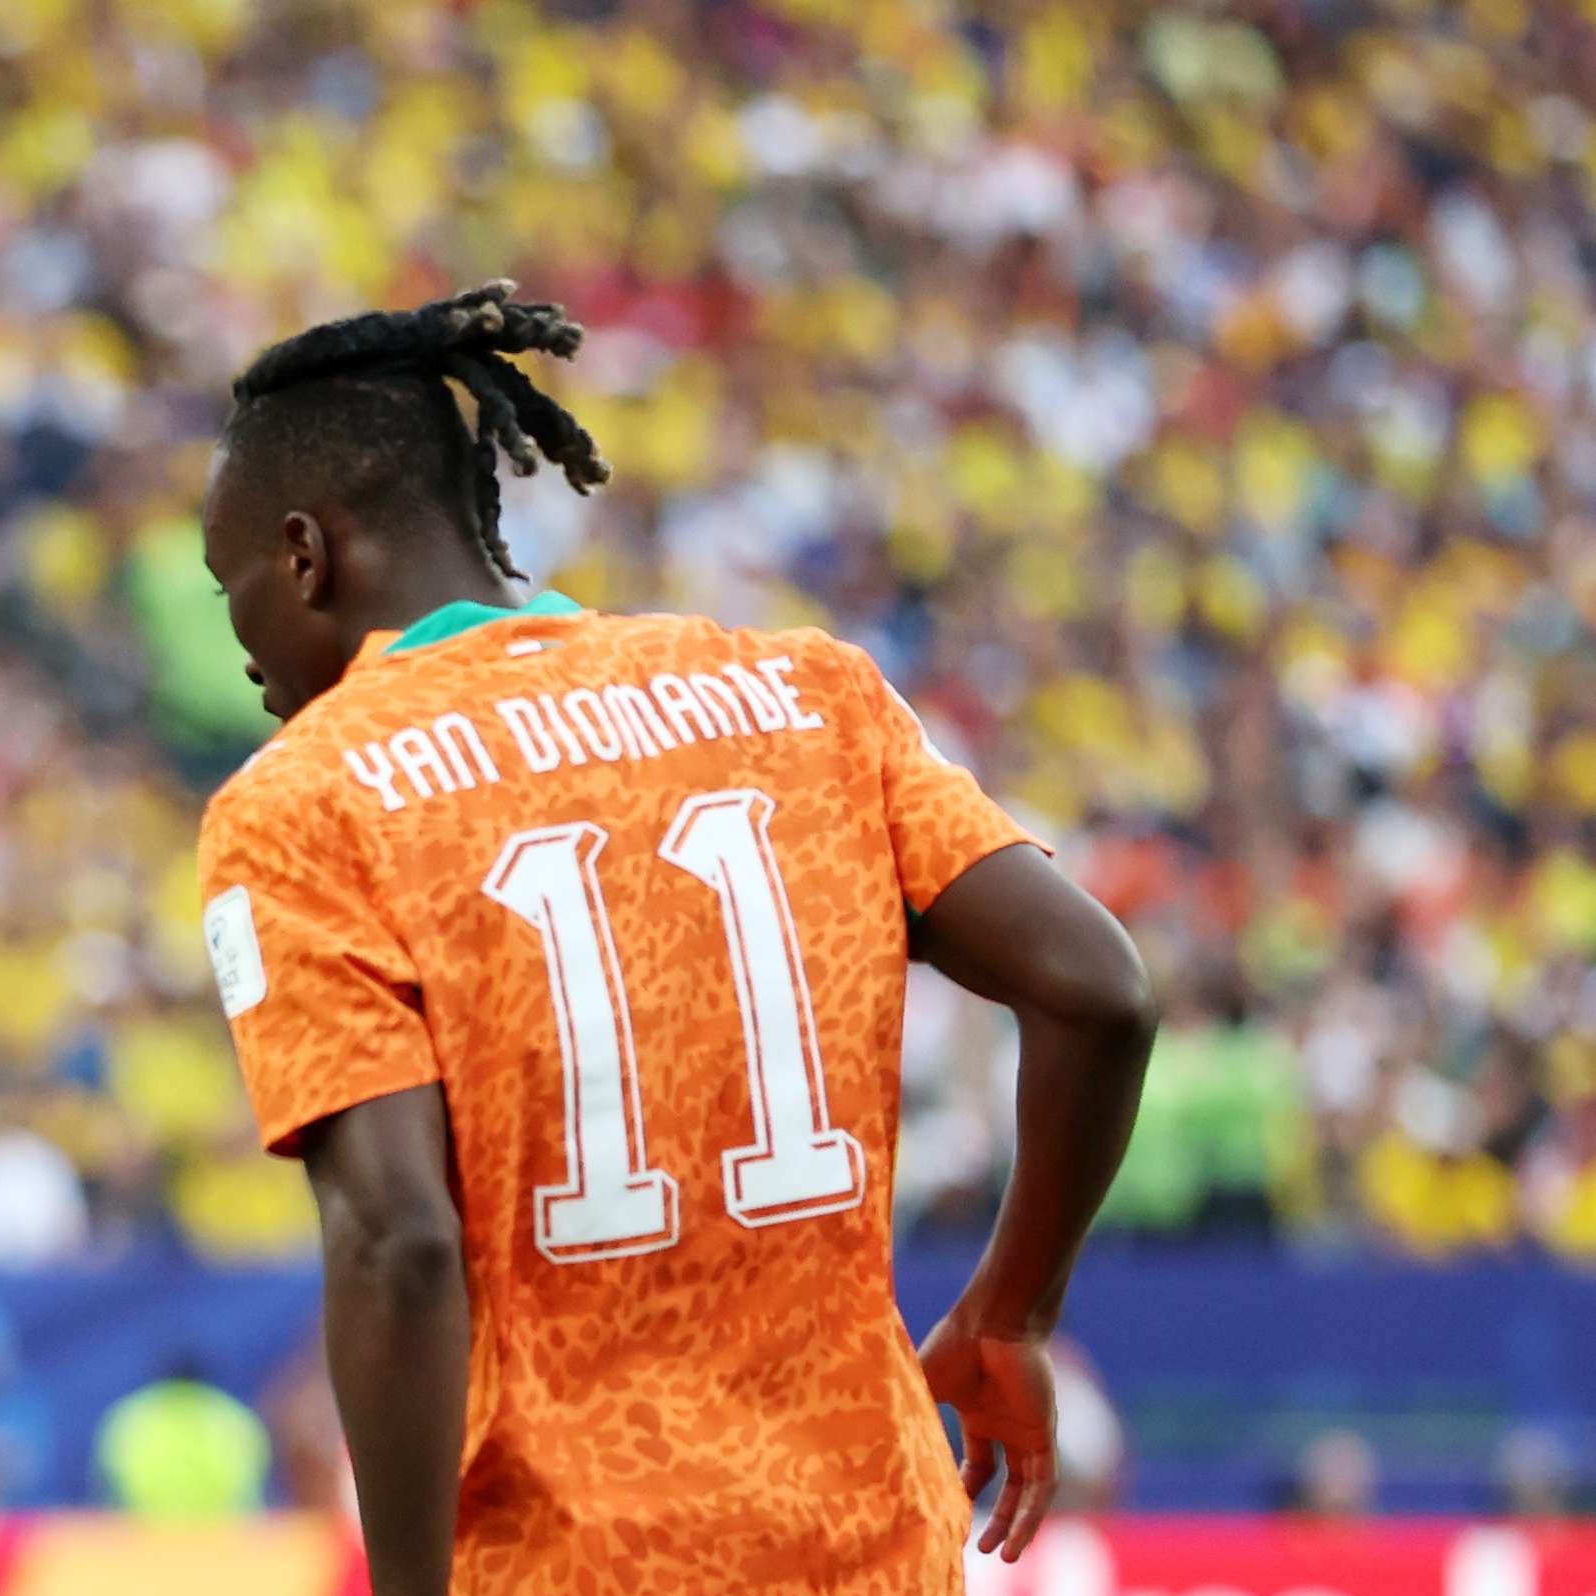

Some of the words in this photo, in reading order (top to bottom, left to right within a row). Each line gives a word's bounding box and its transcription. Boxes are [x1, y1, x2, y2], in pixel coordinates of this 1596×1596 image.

[343, 712, 502, 812] YAN
[495, 655, 825, 774] DIOMANDE
[480, 788, 866, 1265] 11
